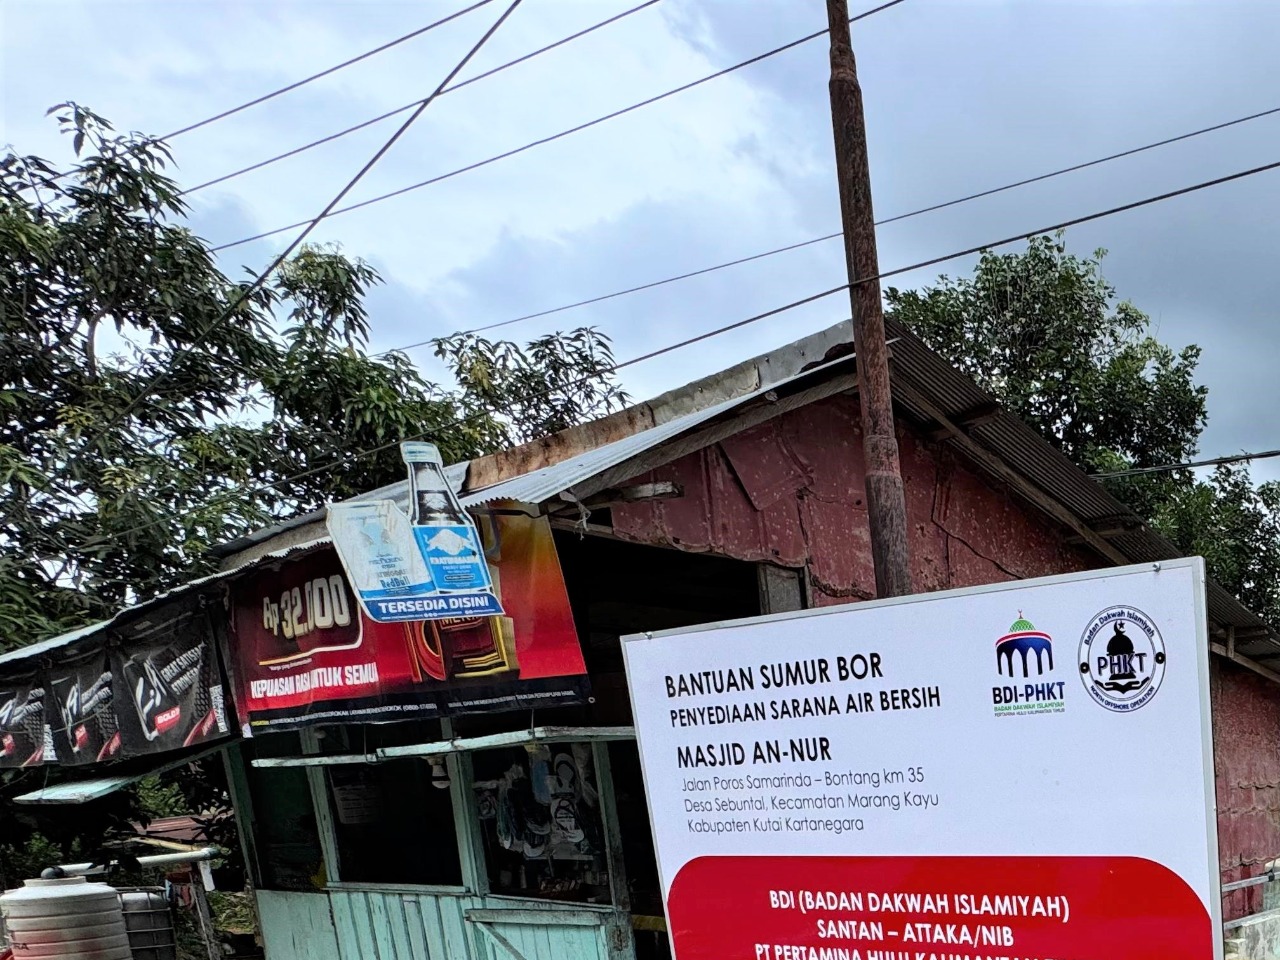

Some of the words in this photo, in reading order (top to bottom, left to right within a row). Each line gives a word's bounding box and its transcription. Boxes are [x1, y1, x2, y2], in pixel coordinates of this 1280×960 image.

[378, 599, 448, 614] TERSEDIA
[449, 596, 489, 608] DISINI
[1084, 623, 1100, 645] Badan
[1098, 610, 1125, 624] Dakwah
[1127, 611, 1155, 637] Islamiyah
[665, 667, 754, 698] BANTUAN
[760, 658, 831, 689] SUMUR
[836, 652, 883, 681] BOR
[1097, 653, 1147, 676] PHKT
[251, 676, 296, 699] KEPUASAN
[992, 681, 1065, 704] BDI-PHKT
[1130, 685, 1155, 709] OPERATION
[670, 701, 766, 727] PENYEDIAAN
[771, 695, 840, 720] SARANA
[846, 692, 875, 714] AIR
[879, 686, 941, 711] BERSIH
[677, 742, 745, 768] MASJID
[752, 737, 832, 764] AN-NUR
[682, 776, 711, 792] Jalan
[714, 776, 744, 791] Poros
[746, 772, 812, 790] Samarinda
[825, 770, 881, 788] Bontang
[883, 768, 904, 784] km
[907, 767, 925, 783] 35
[684, 798, 712, 813] Desa
[715, 796, 768, 812] Sebuntal,
[771, 794, 845, 810] Kecamatan
[848, 792, 901, 810] Marang
[904, 791, 939, 809] Kayu
[687, 818, 751, 836] Kabupaten
[753, 817, 783, 832] Kutai
[785, 817, 864, 835] Kartanegara
[769, 890, 795, 909] BDI
[798, 890, 863, 914] (BADAN
[868, 893, 949, 914] DAKWAH
[954, 894, 1070, 923] ISLAMIYAH)
[816, 919, 883, 941] SANTAN
[903, 922, 1014, 948] ATTAKA/NIB
